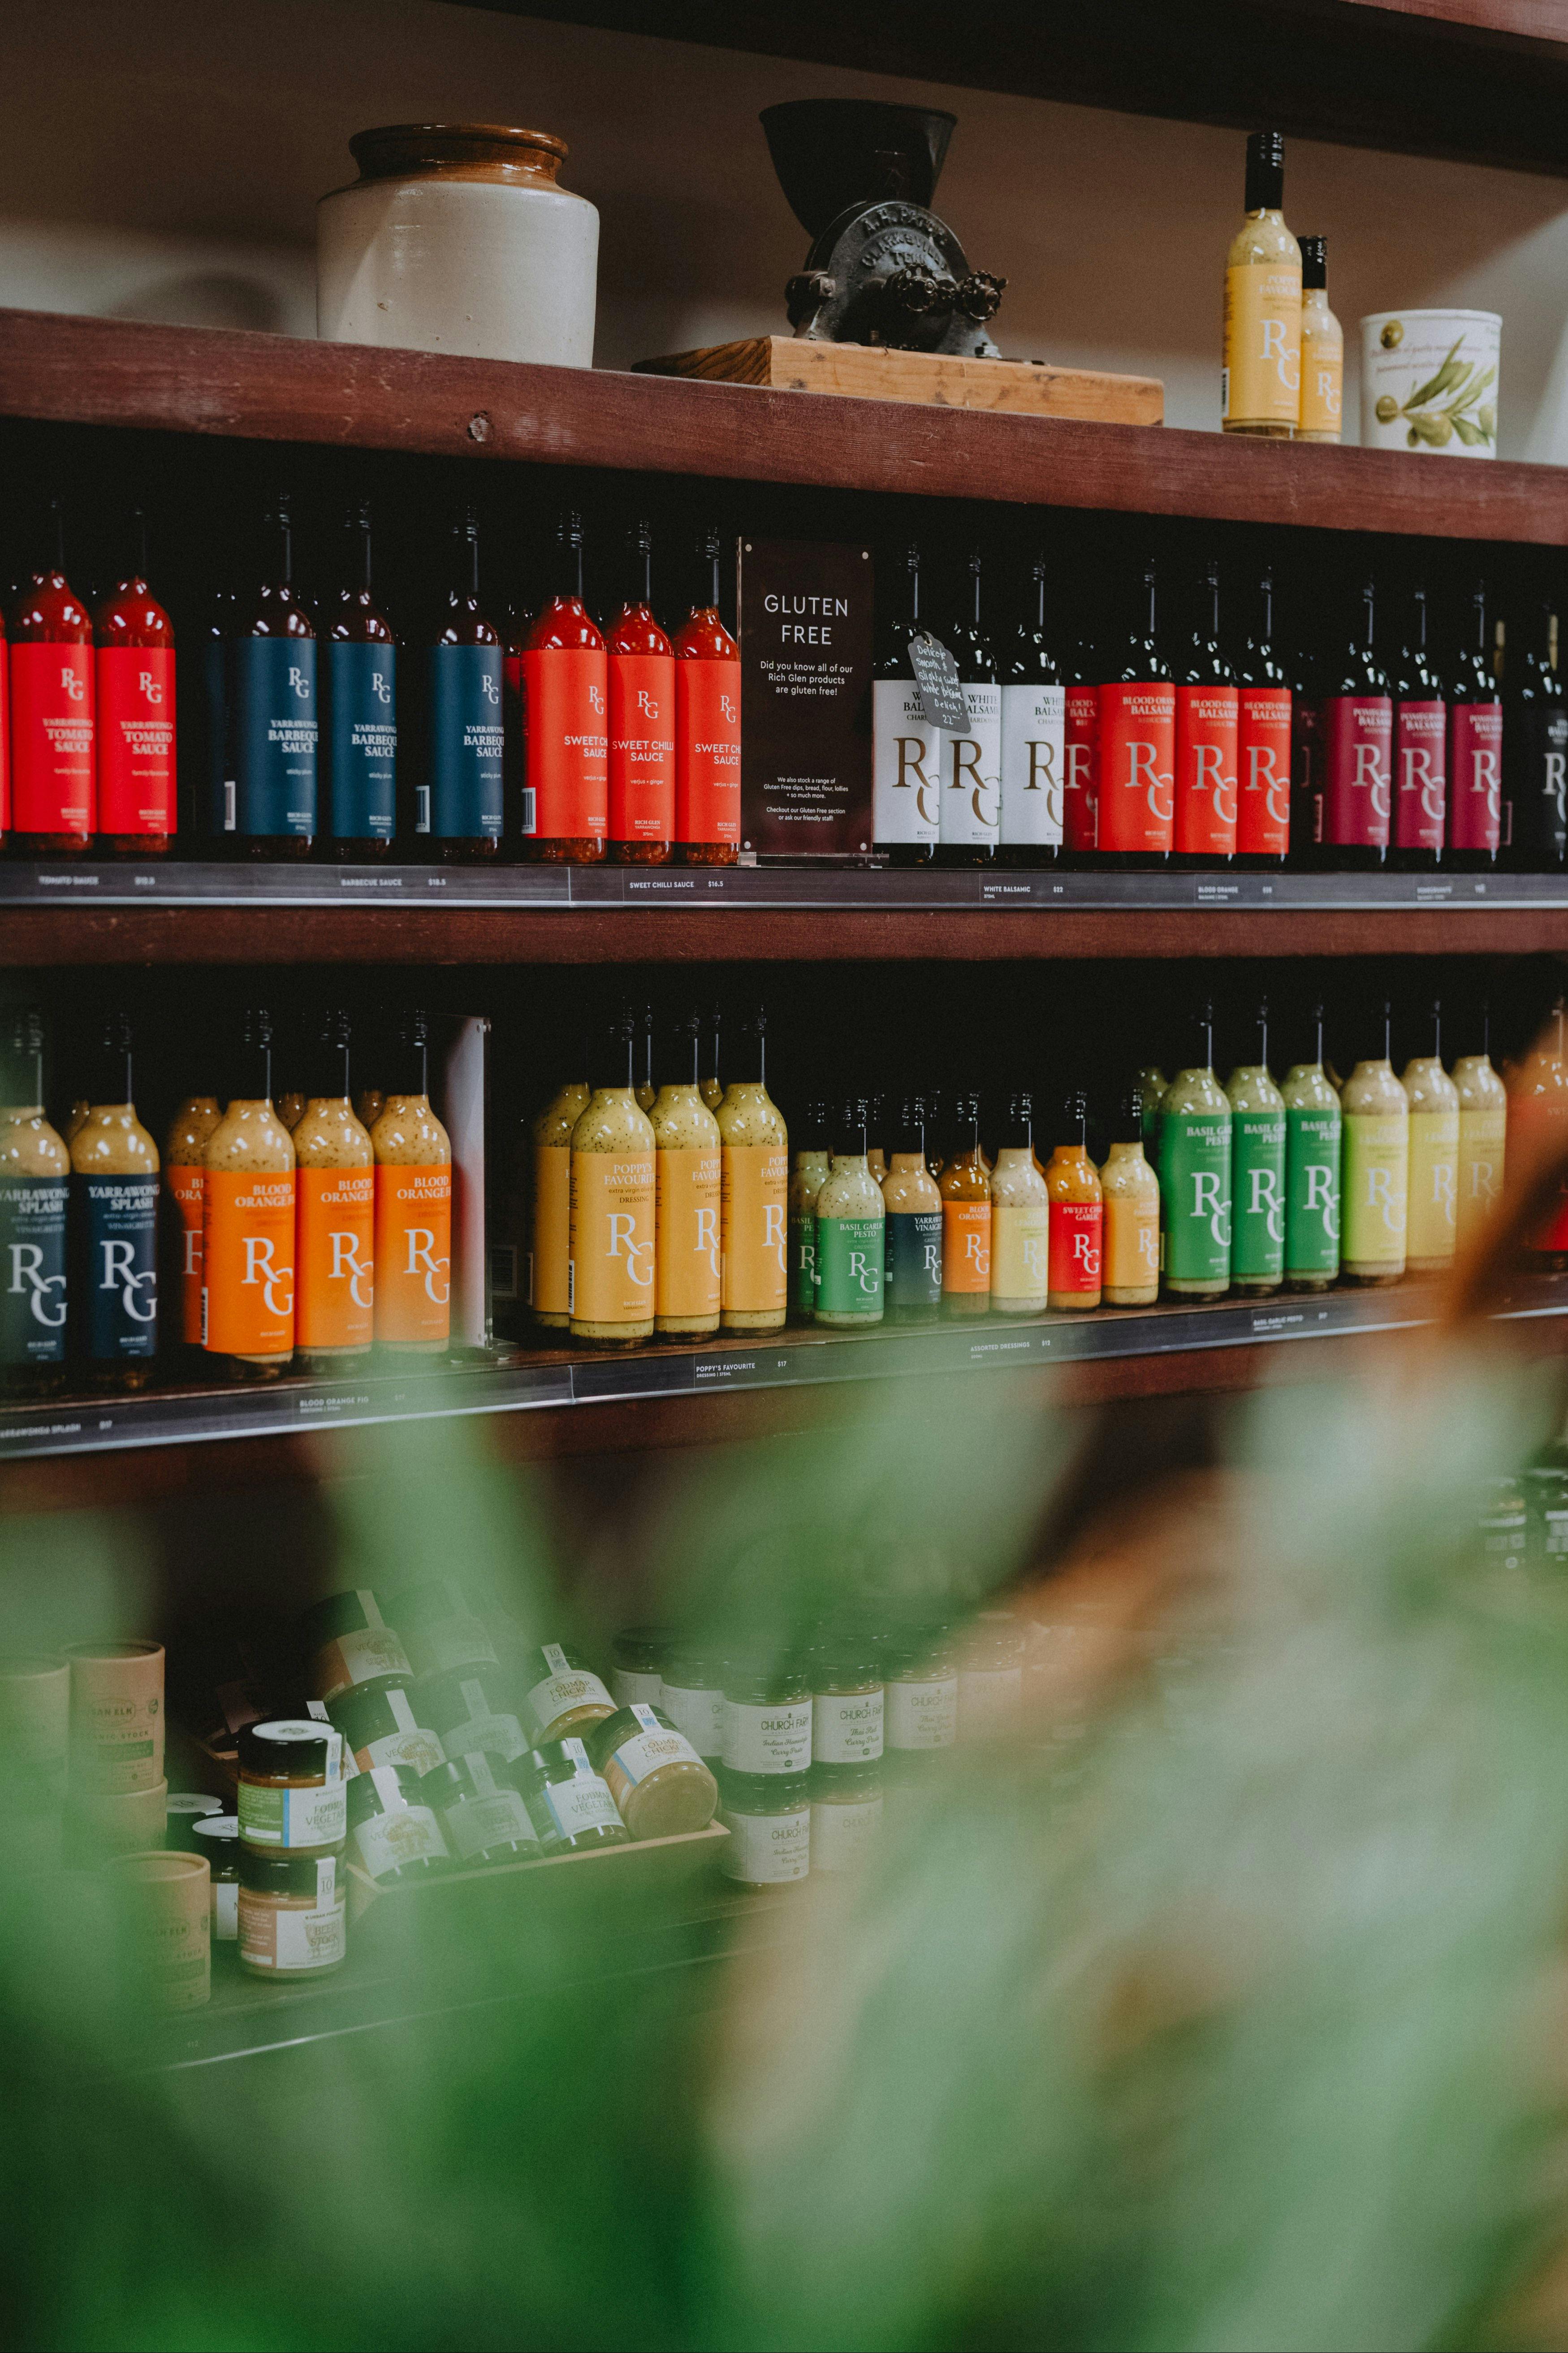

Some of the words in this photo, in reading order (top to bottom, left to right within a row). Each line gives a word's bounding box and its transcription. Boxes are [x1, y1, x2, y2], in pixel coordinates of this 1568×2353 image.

[765, 594, 847, 617] GLUTEN
[782, 625, 831, 644] FREE
[760, 661, 774, 669] Did
[777, 663, 791, 671] you
[794, 662, 815, 670] know
[818, 663, 827, 671] all
[830, 664, 838, 672] of
[61, 668, 84, 700] RG
[289, 667, 310, 699] RG
[769, 673, 785, 681] Rich
[788, 674, 806, 682] Glen
[809, 675, 845, 684] products
[139, 672, 162, 703] RG
[372, 673, 390, 703] RG
[482, 675, 499, 704] RG
[791, 685, 816, 695] gluten
[819, 686, 837, 695] free!
[589, 686, 604, 715] RG
[638, 691, 659, 719] RG
[968, 694, 998, 704] WHITE
[720, 695, 736, 723] RG
[564, 735, 598, 746] SWEET
[612, 740, 649, 750] SWEET
[652, 741, 674, 751] CHILLI
[132, 743, 168, 755] SAUCE
[281, 742, 314, 753] SAUCE
[365, 746, 394, 757] SAUCE
[476, 747, 502, 757] SAUCE
[583, 748, 607, 758] SAUCE
[695, 744, 730, 753] SWEET
[631, 752, 664, 761] SAUCE
[713, 756, 739, 765] SAUCE
[947, 740, 999, 826] RG
[1125, 742, 1173, 821] RG
[1192, 744, 1237, 823] RG
[1245, 746, 1291, 824] RG
[1401, 748, 1445, 821] RG
[341, 878, 378, 887] BARBECUE
[613, 1163, 652, 1175] POPPY'S
[338, 1178, 372, 1191] BLOOD
[414, 1175, 449, 1188] BLOOD
[252, 1183, 292, 1196] BLOOD
[111, 1197, 154, 1210] SPLASH
[606, 1213, 654, 1286] RG
[965, 1234, 989, 1274] RG
[1073, 1233, 1100, 1275] RG
[1138, 1228, 1159, 1268] RG
[328, 1231, 374, 1308] RG
[403, 1228, 451, 1304] RG
[923, 1245, 942, 1285] RG
[241, 1237, 294, 1316] RG
[848, 1252, 879, 1293] RG
[7, 1243, 68, 1327] RG
[99, 1240, 158, 1322] RG
[1000, 1341, 1030, 1350] DRESSINGS
[299, 1398, 324, 1408] BLOOD
[326, 1397, 355, 1406] ORANGE
[549, 1649, 560, 1657] 10
[549, 1680, 590, 1696] FODMAP
[552, 1686, 596, 1703] CHICKEN
[911, 1696, 942, 1707] CHURCH
[638, 1709, 650, 1717] 10
[840, 1708, 871, 1720] CHURCH
[761, 1719, 794, 1731] CHURCH
[851, 1727, 865, 1736] Thai
[865, 1725, 877, 1734] Red
[573, 1744, 583, 1754] 10
[641, 1739, 683, 1752] FODMAP
[845, 1738, 865, 1747] Curry
[772, 1828, 801, 1840] CHURCH
[322, 1879, 333, 1892] 10
